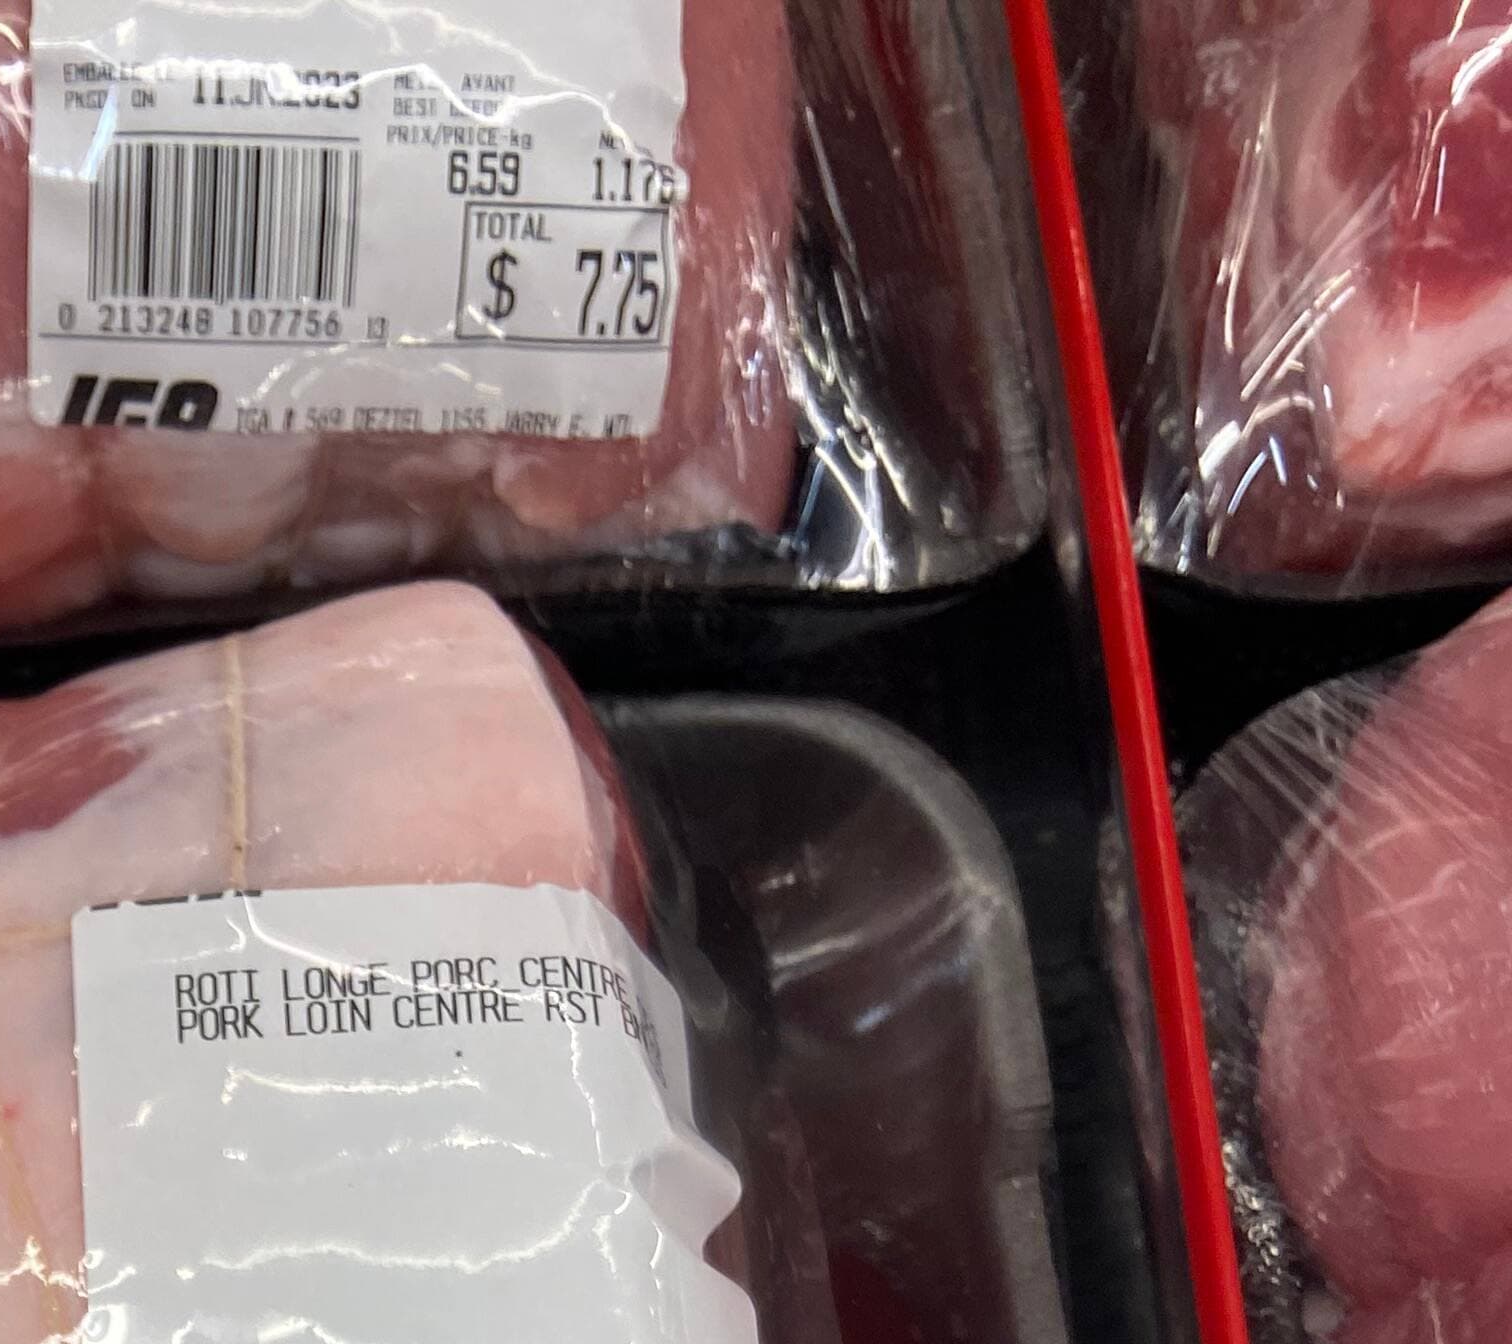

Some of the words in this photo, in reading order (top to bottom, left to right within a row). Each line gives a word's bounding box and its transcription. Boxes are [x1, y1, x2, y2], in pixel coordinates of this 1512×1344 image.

[447, 151, 521, 197] 6.59
[474, 212, 553, 243] TOTAL
[484, 249, 518, 322] $
[576, 249, 661, 337] 7.75
[58, 302, 76, 331] 0
[98, 304, 214, 335] 213248
[230, 307, 343, 338] 107756
[175, 969, 260, 1008] ROTI
[282, 963, 390, 1002] LONGE
[411, 956, 499, 992] PORC
[519, 955, 631, 1009] CENTRE
[176, 1003, 264, 1043] PORK
[285, 998, 373, 1036] LOIN
[393, 988, 524, 1028] CENTRE
[544, 989, 604, 1027] RST
